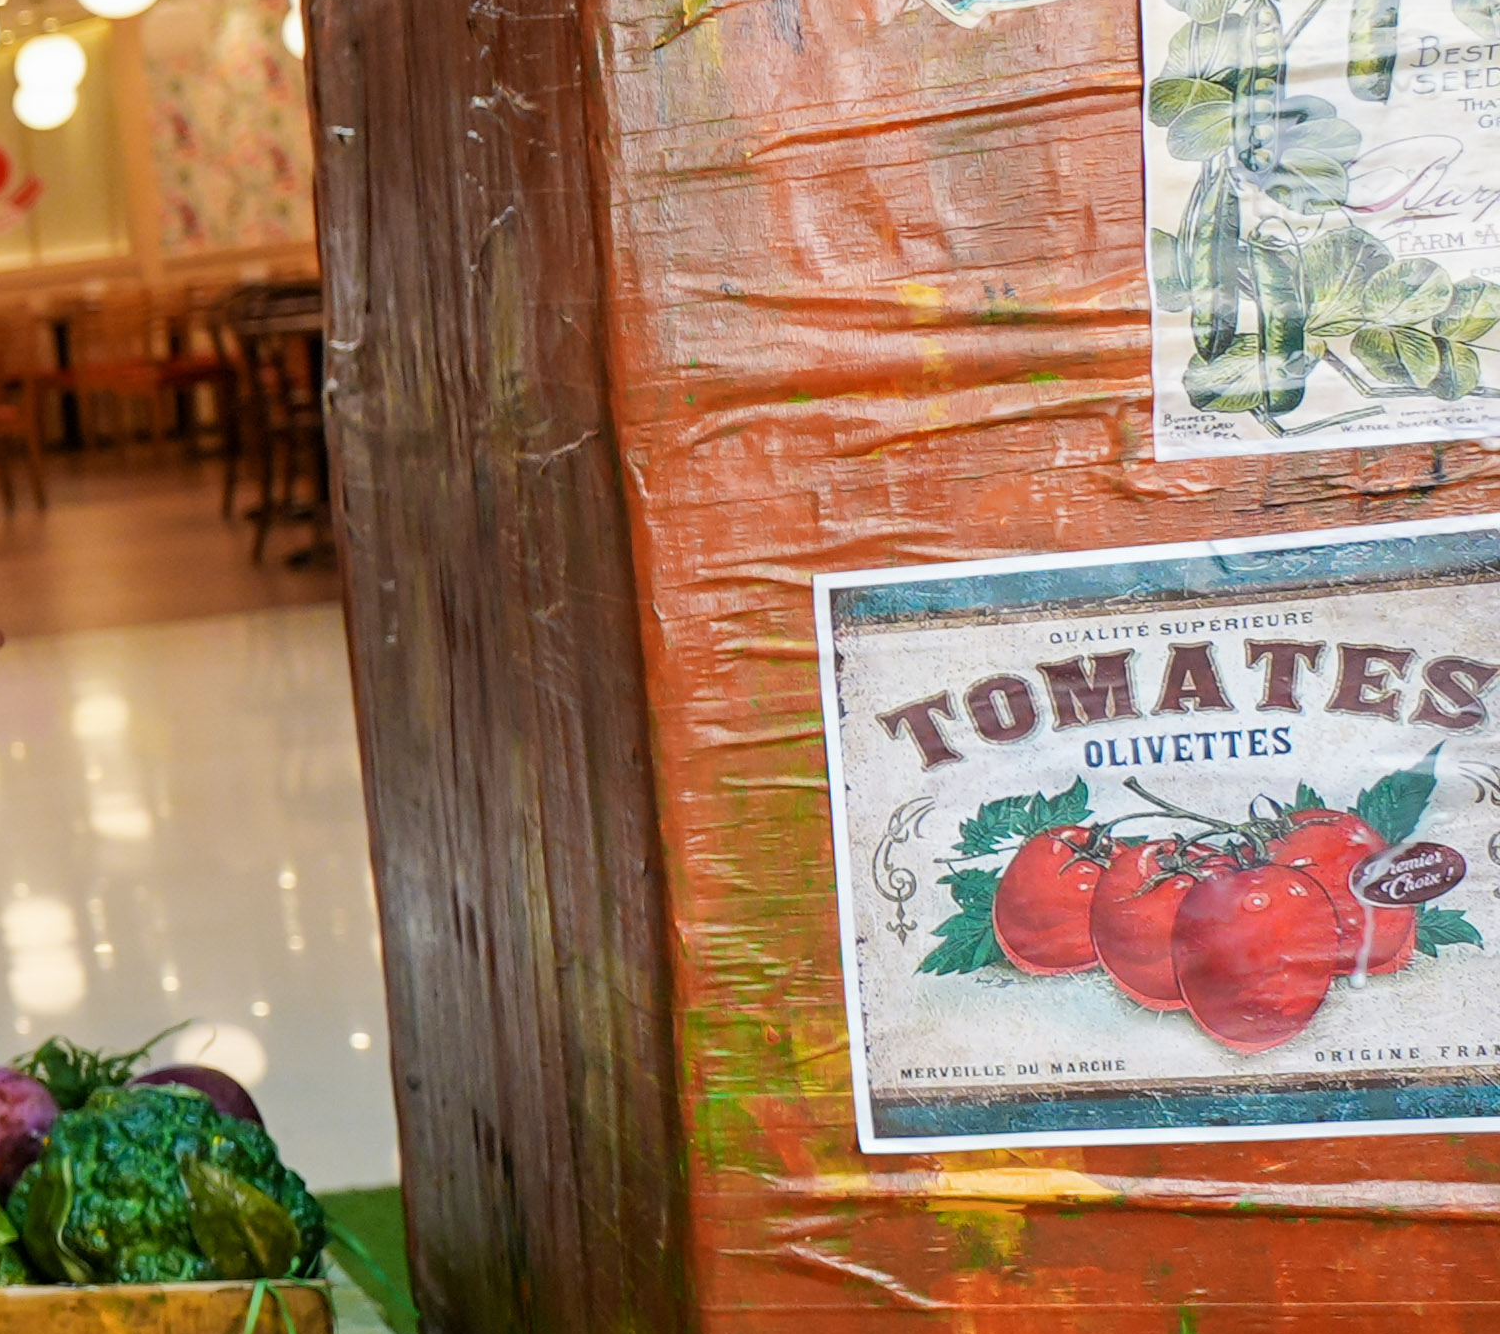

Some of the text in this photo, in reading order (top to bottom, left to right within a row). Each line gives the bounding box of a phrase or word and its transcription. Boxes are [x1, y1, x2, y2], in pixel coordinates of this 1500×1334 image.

[1409, 36, 1500, 68] BEST
[1397, 231, 1466, 253] FARM
[1049, 610, 1315, 645] QUALITÉ SUPÉRIEURE
[875, 639, 1500, 771] TOMATES
[1083, 725, 1294, 770] OLIVETTES
[900, 1064, 1006, 1080] MERVEILLE
[1016, 1062, 1040, 1076] DU
[1315, 1047, 1421, 1063] ORIGINE
